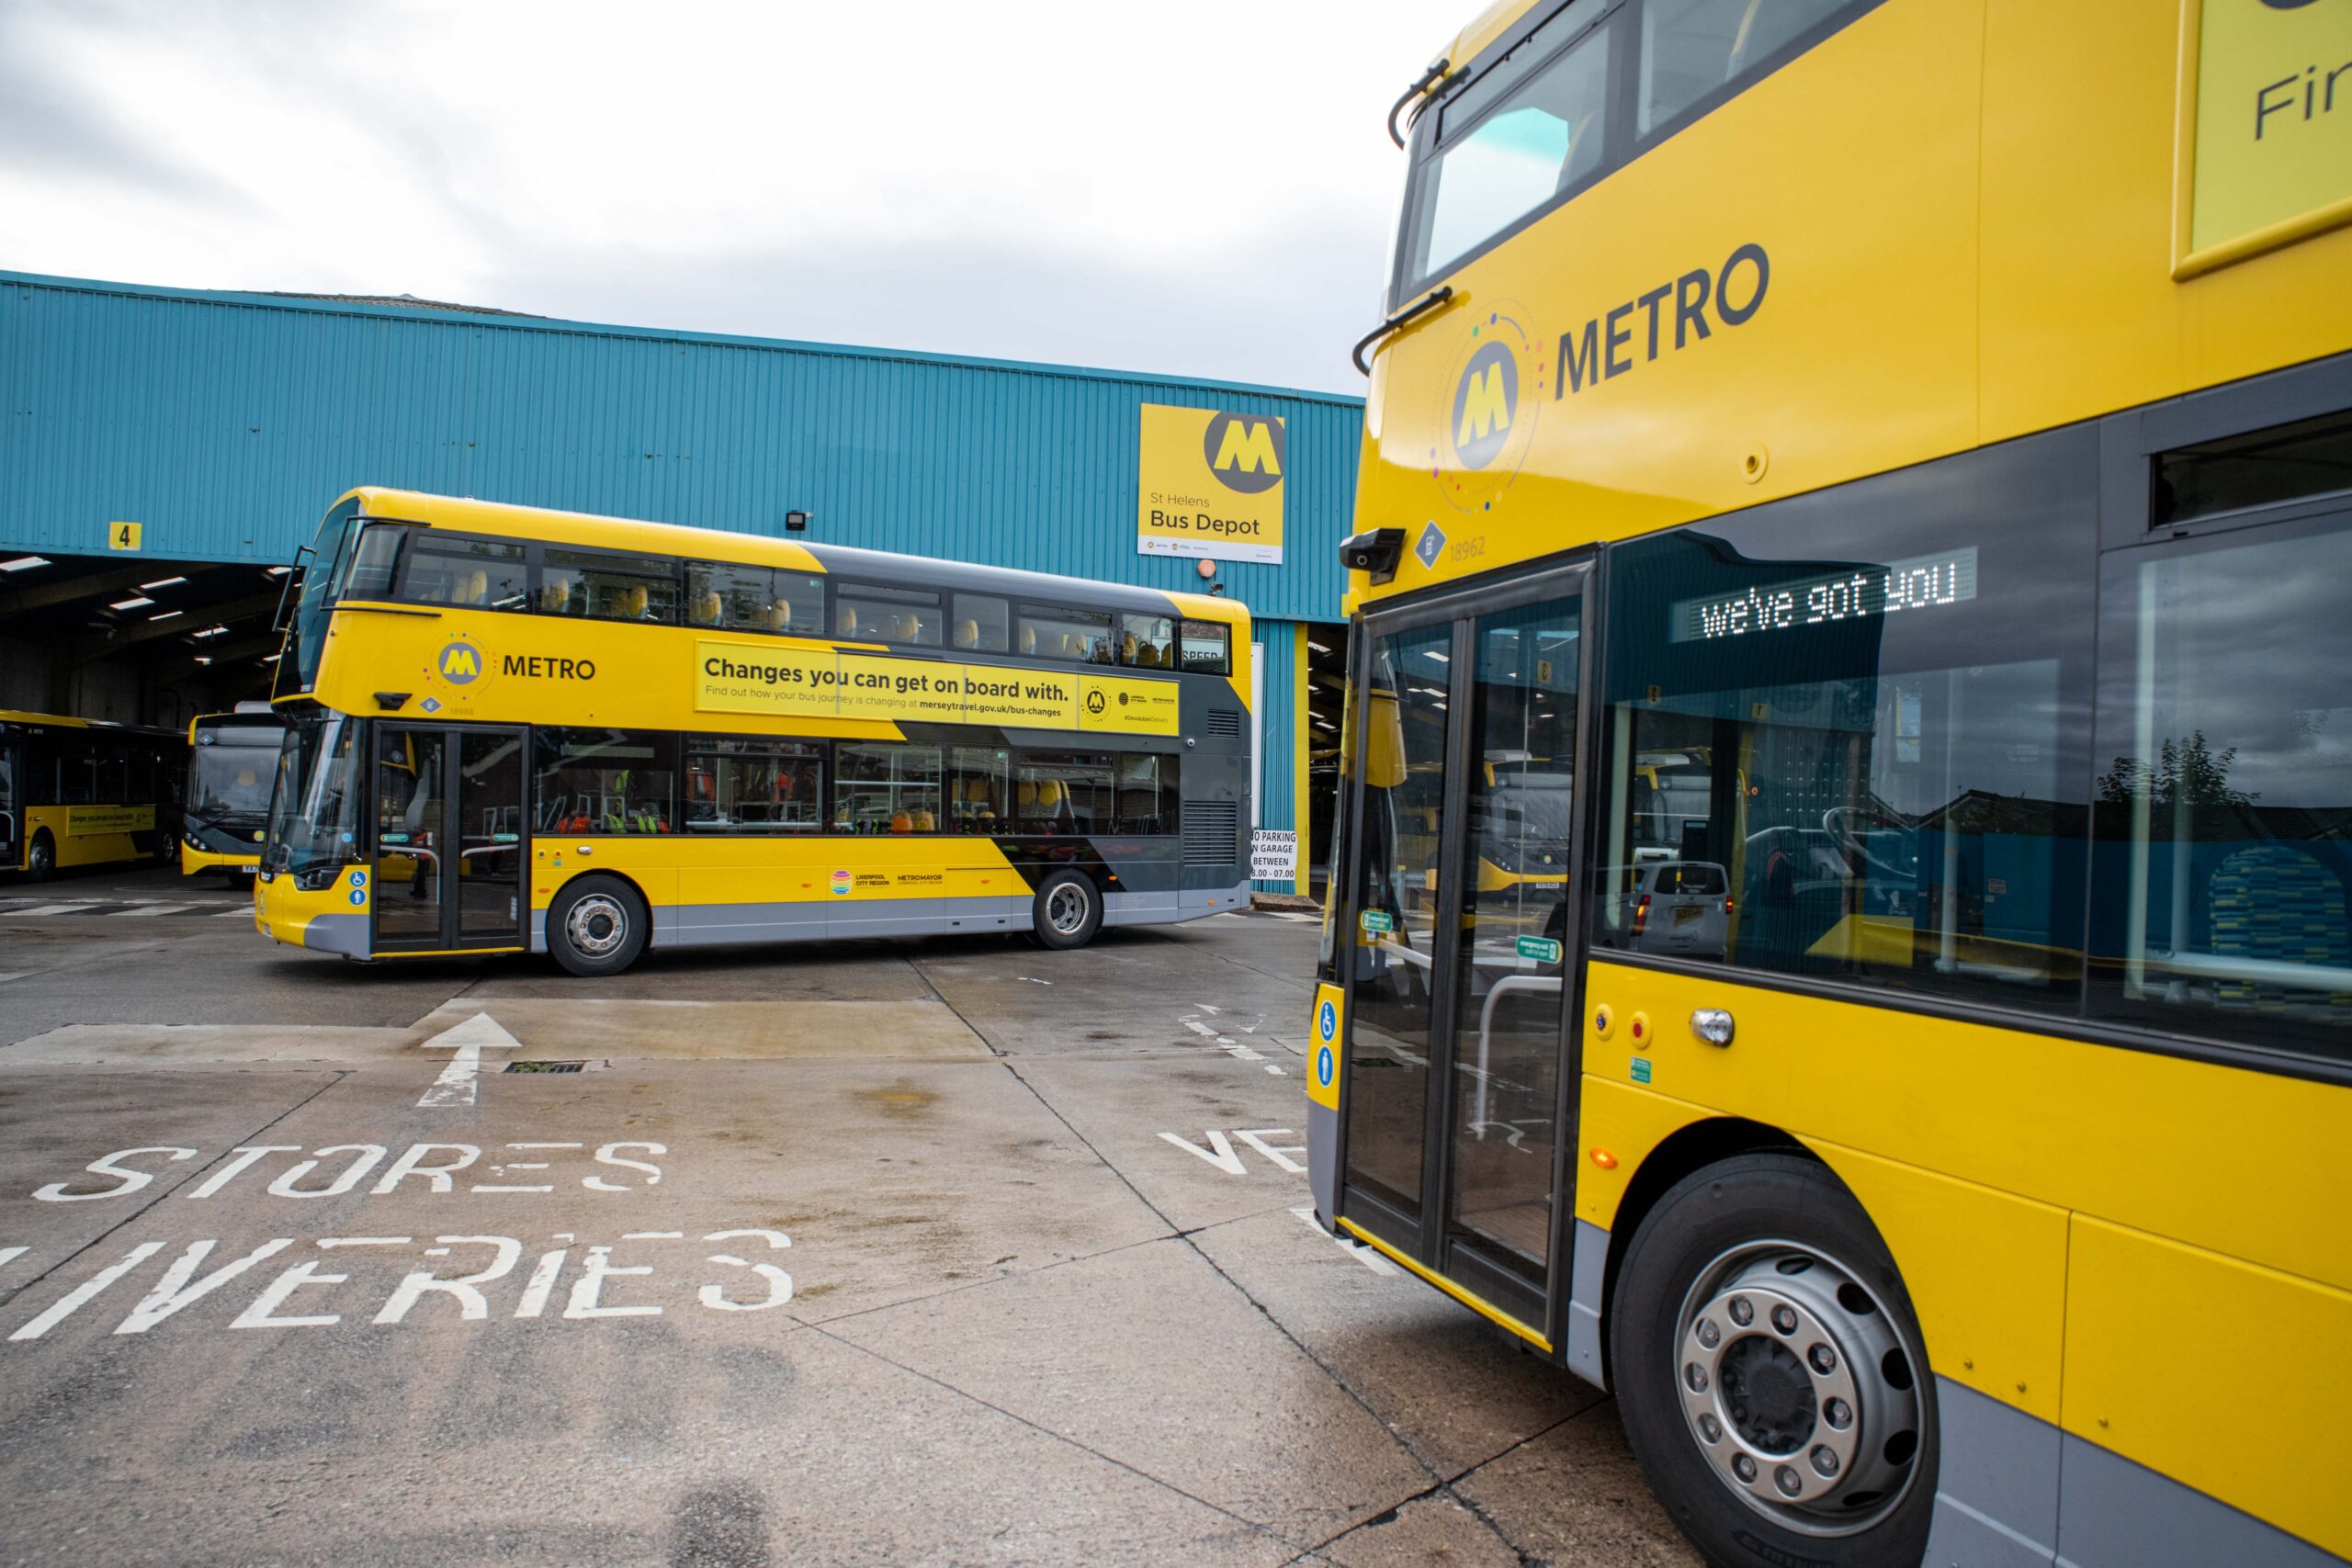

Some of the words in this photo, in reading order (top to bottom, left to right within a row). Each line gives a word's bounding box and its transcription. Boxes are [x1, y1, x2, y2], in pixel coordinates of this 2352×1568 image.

[1555, 243, 1770, 401] METRO
[1456, 359, 1510, 449] M
[1213, 420, 1282, 476] M
[1150, 492, 1163, 504] St
[1168, 494, 1210, 507] Helens
[119, 525, 130, 547] 4
[1150, 510, 1189, 528] Bus
[1196, 514, 1260, 536] Depot
[1450, 536, 1486, 563] 18962
[1702, 587, 1793, 638] we've
[1807, 574, 1867, 624] got
[1883, 563, 1955, 612] you
[443, 649, 478, 675] M
[503, 655, 595, 680] METRO
[705, 658, 803, 684] Changes
[809, 670, 849, 688] you
[854, 673, 890, 689] can
[896, 675, 928, 694] get
[934, 679, 958, 694] on
[966, 677, 1020, 698] board
[1025, 682, 1069, 702] with.
[706, 685, 727, 696] Find
[751, 689, 771, 698] how
[775, 692, 796, 701] your
[798, 692, 816, 701] bus
[818, 693, 853, 705] journey
[856, 694, 864, 704] is
[865, 696, 906, 709] changing
[909, 699, 917, 707] at
[920, 701, 1061, 716] merseytravel.gov.uk/bus-changes
[1261, 844, 1293, 853] GARAGE
[1262, 832, 1296, 842] PARKING
[1253, 857, 1289, 865] BETWEEN
[1273, 869, 1295, 878] 07.00
[32, 1141, 668, 1202] STORES
[0, 1228, 794, 1340] IVERIES
